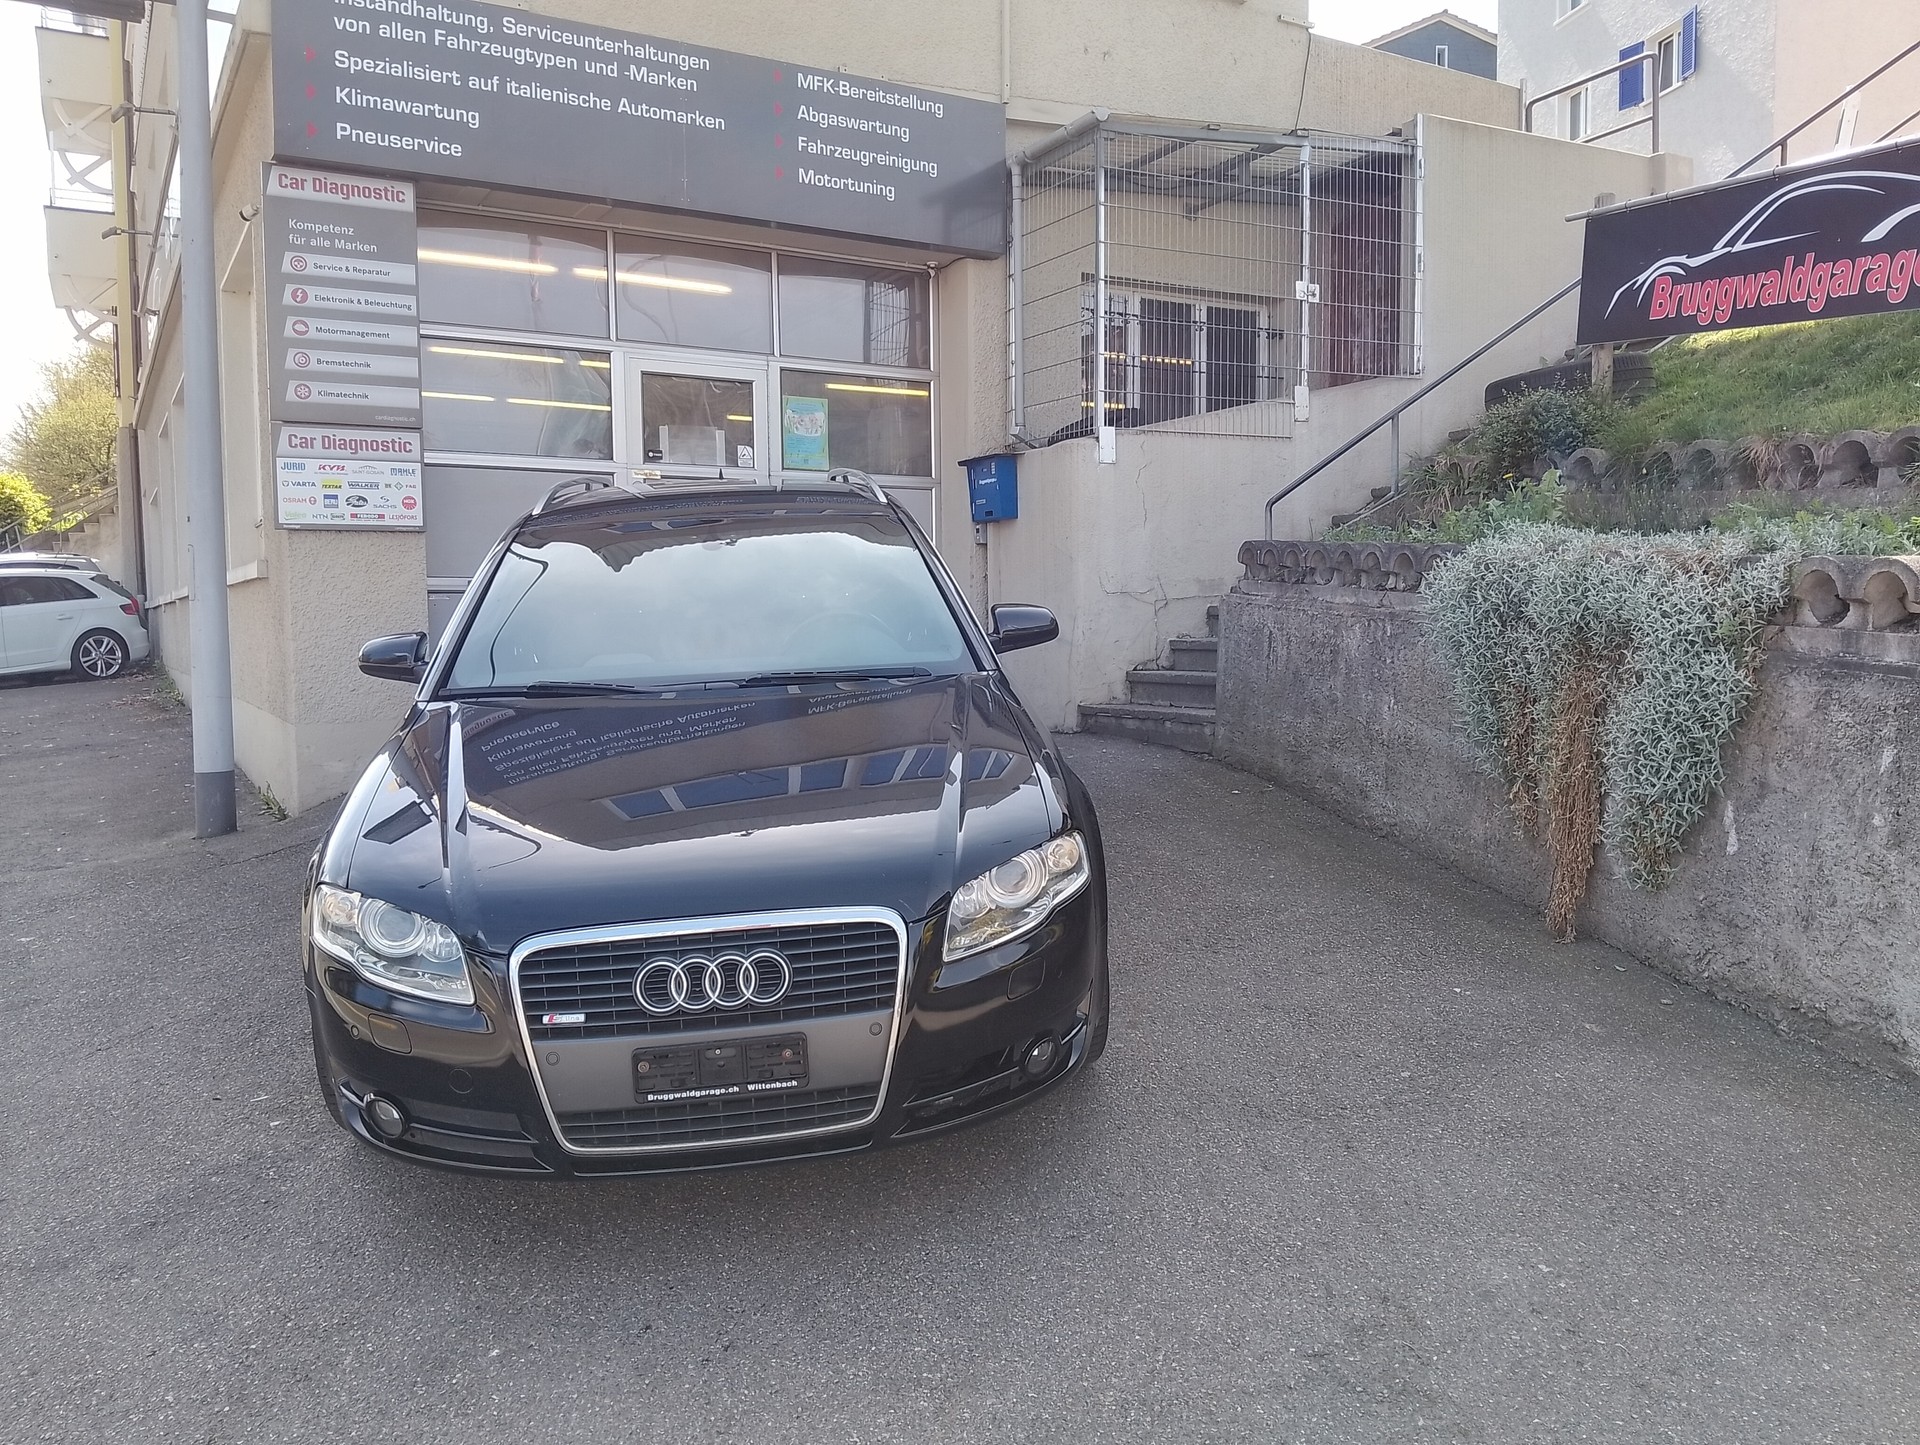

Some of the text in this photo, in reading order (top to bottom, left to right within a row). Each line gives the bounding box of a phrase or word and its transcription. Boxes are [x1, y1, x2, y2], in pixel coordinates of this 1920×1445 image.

[334, 0, 710, 71] standhaltung, Serviceunterhaltungen
[333, 16, 697, 93] von allen Fahrzeugtypen und -Marken
[334, 49, 726, 131] Spezialisiert auf italienische Automarken
[797, 73, 944, 118] MFK-Bereitstellung
[335, 86, 480, 128] Klimawartung
[797, 105, 910, 142] Abgaswartung
[336, 123, 462, 157] Pneuservice
[798, 136, 938, 177] Fahrzeugreinigung
[278, 173, 406, 203] Car Diagnostic
[798, 168, 895, 201] Motortuning
[288, 218, 354, 235] Kompetenz
[288, 233, 377, 252] für alle Marken
[313, 262, 391, 277] Service & Reparatur
[314, 294, 355, 305] Elektronik
[364, 299, 412, 311] Beleuchtung
[315, 326, 390, 339] Motormanagement
[316, 358, 372, 369] Bremstechnik
[317, 390, 370, 400] Klimatechnik
[288, 433, 413, 455] Car Diagnostic
[281, 462, 306, 471] JURID
[347, 481, 380, 490] WALKER
[647, 1080, 798, 1101] Bruggwaldgarage.ch Wittenbach
